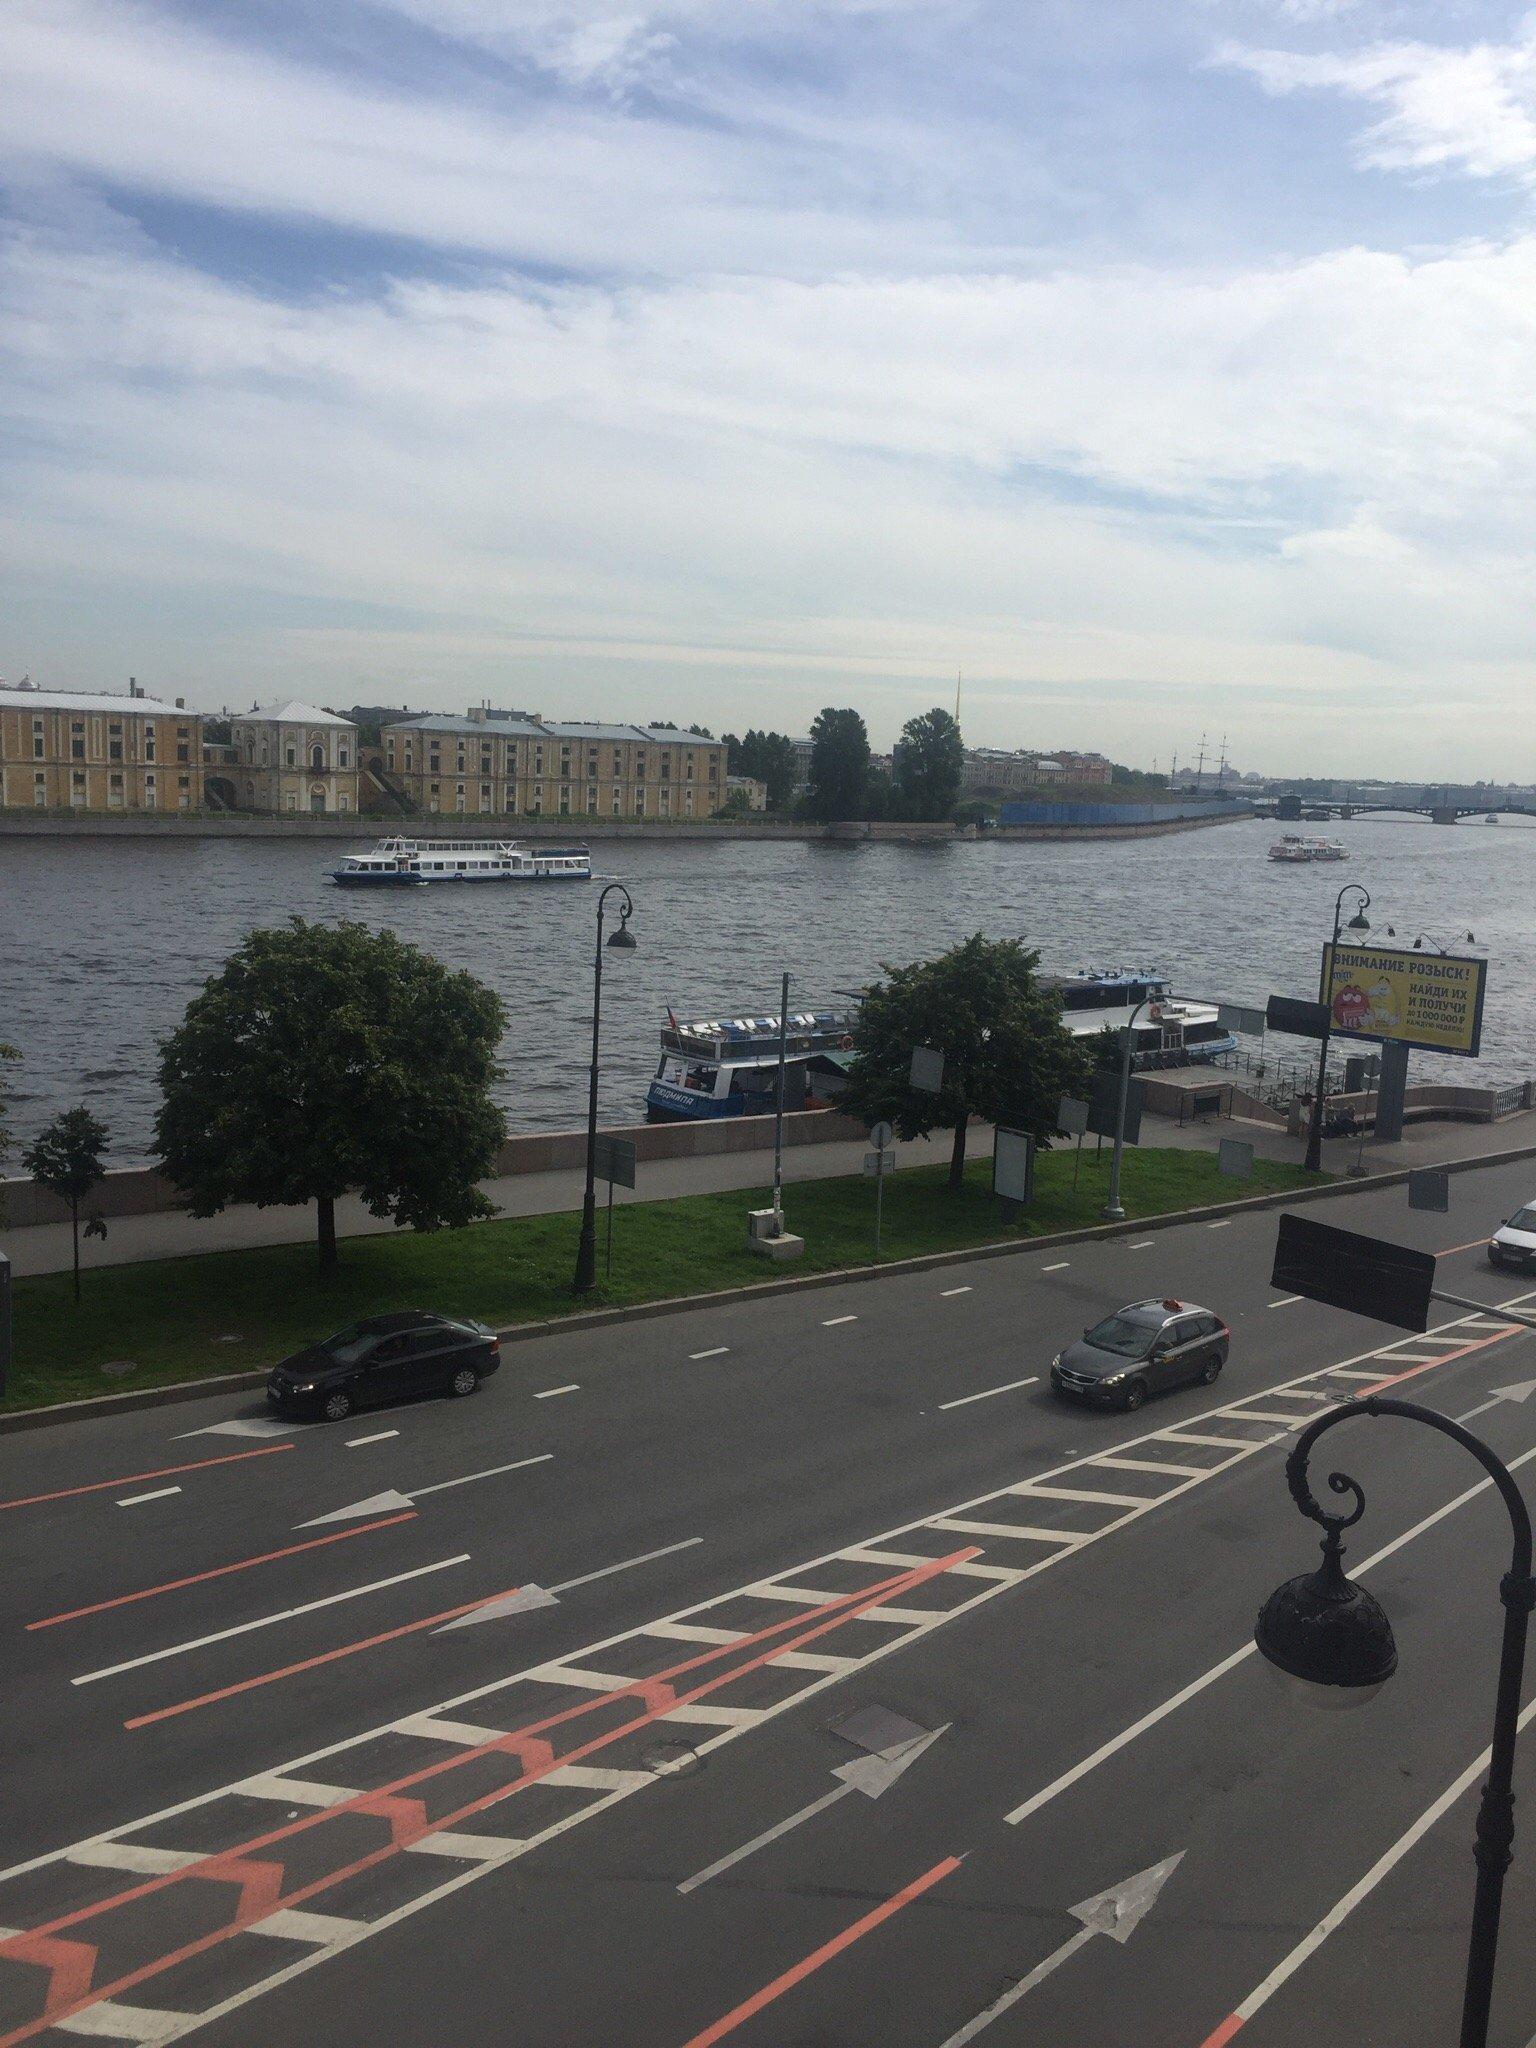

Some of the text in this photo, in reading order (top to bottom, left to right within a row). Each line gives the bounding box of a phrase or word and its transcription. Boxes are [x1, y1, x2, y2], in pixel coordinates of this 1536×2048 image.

[1333, 953, 1470, 980] ВНИМАНИЕ РОЗЫСК!
[1409, 983, 1468, 1000] НАЙДИ ИХ
[1408, 997, 1466, 1013] И ПОЛУЧИ
[653, 1086, 694, 1105] ЛЮДМИЛА
